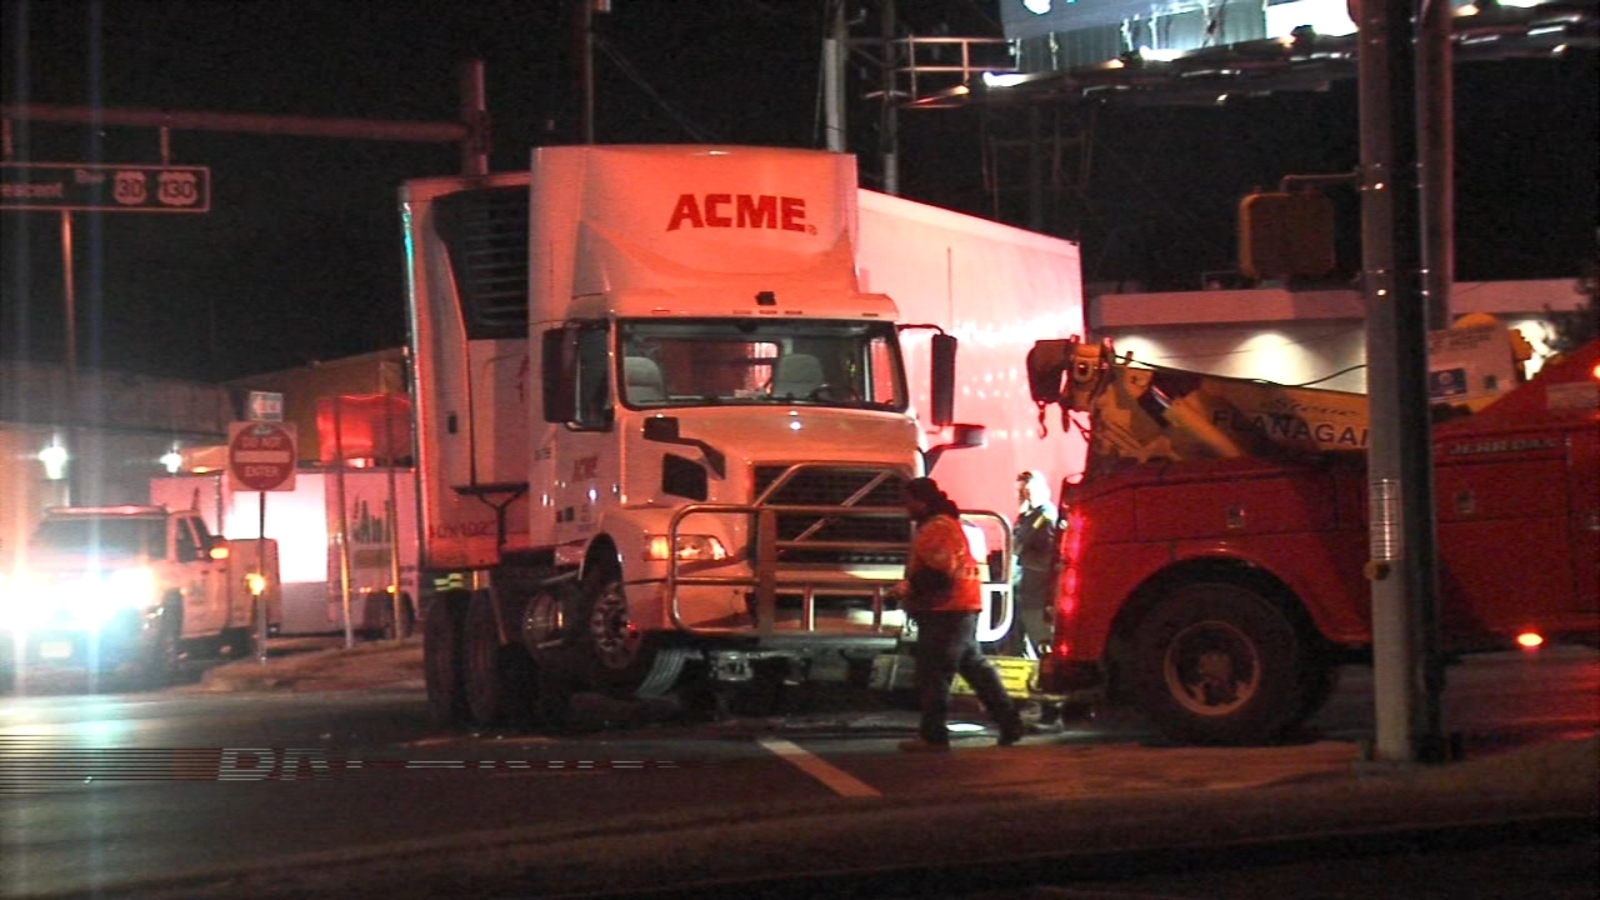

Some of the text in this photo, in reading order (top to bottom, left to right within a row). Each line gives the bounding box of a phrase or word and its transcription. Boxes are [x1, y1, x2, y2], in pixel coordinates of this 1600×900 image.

[119, 179, 142, 198] 30
[162, 180, 193, 199] 130
[666, 193, 806, 232] ACME
[244, 466, 279, 477] ENTER
